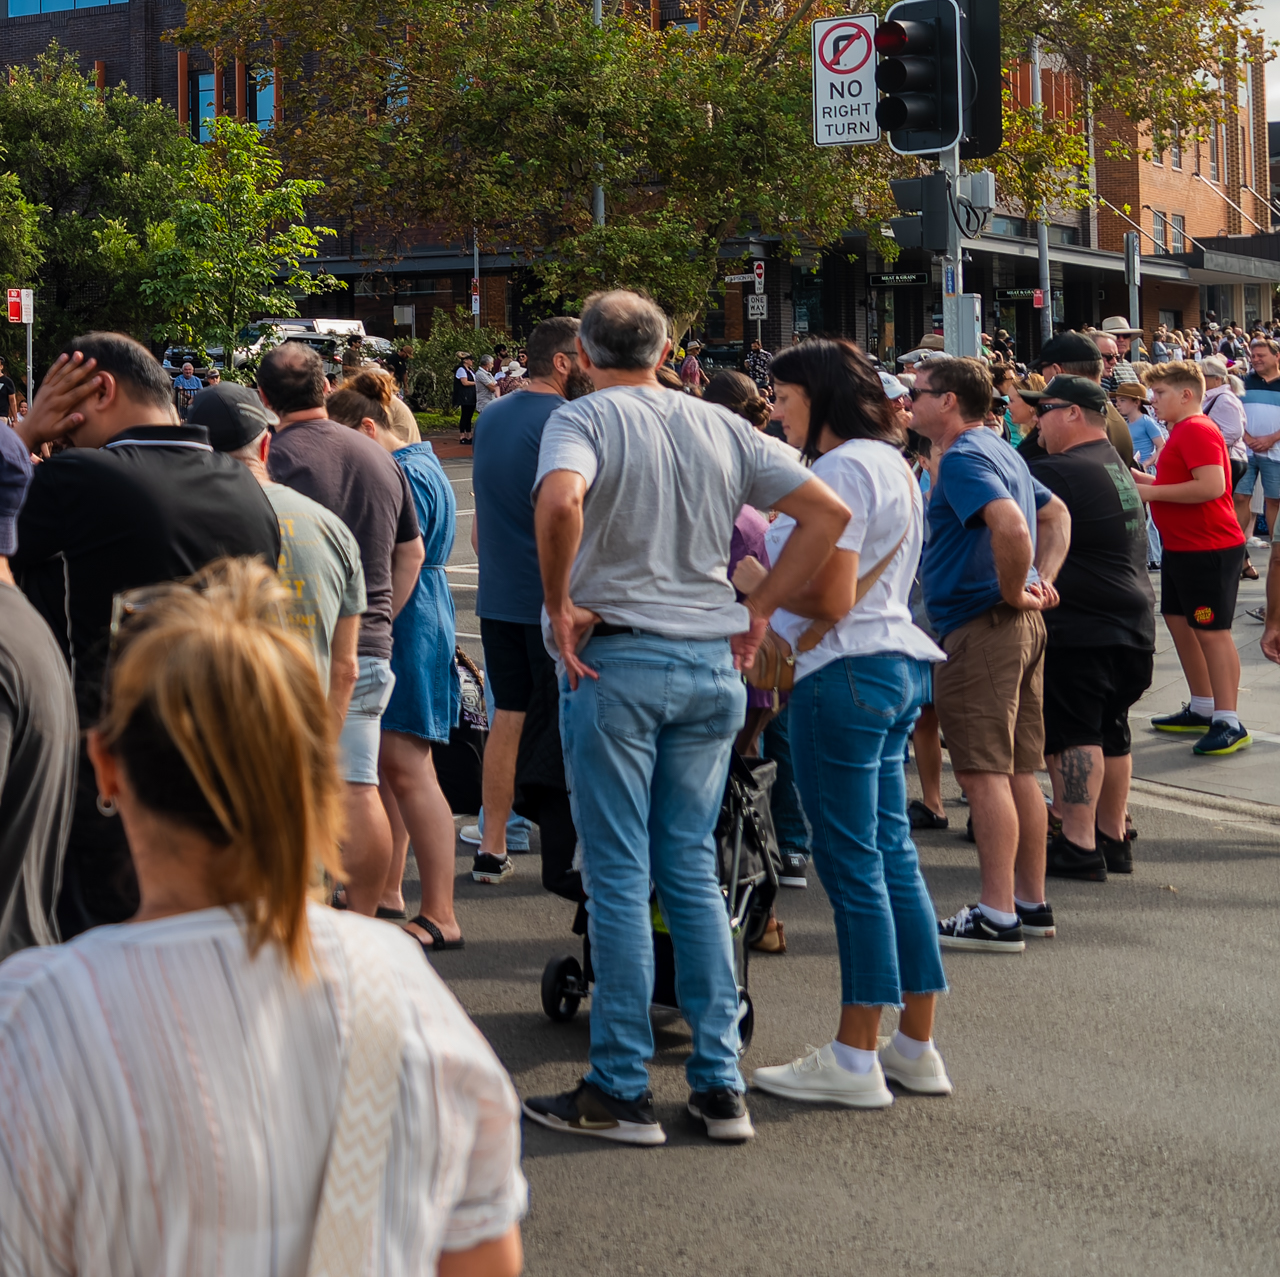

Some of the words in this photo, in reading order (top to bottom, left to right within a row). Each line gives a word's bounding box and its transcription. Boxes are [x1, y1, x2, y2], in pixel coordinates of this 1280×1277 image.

[829, 79, 863, 100] NO
[822, 102, 871, 119] RIGHT
[824, 120, 870, 137] TURN
